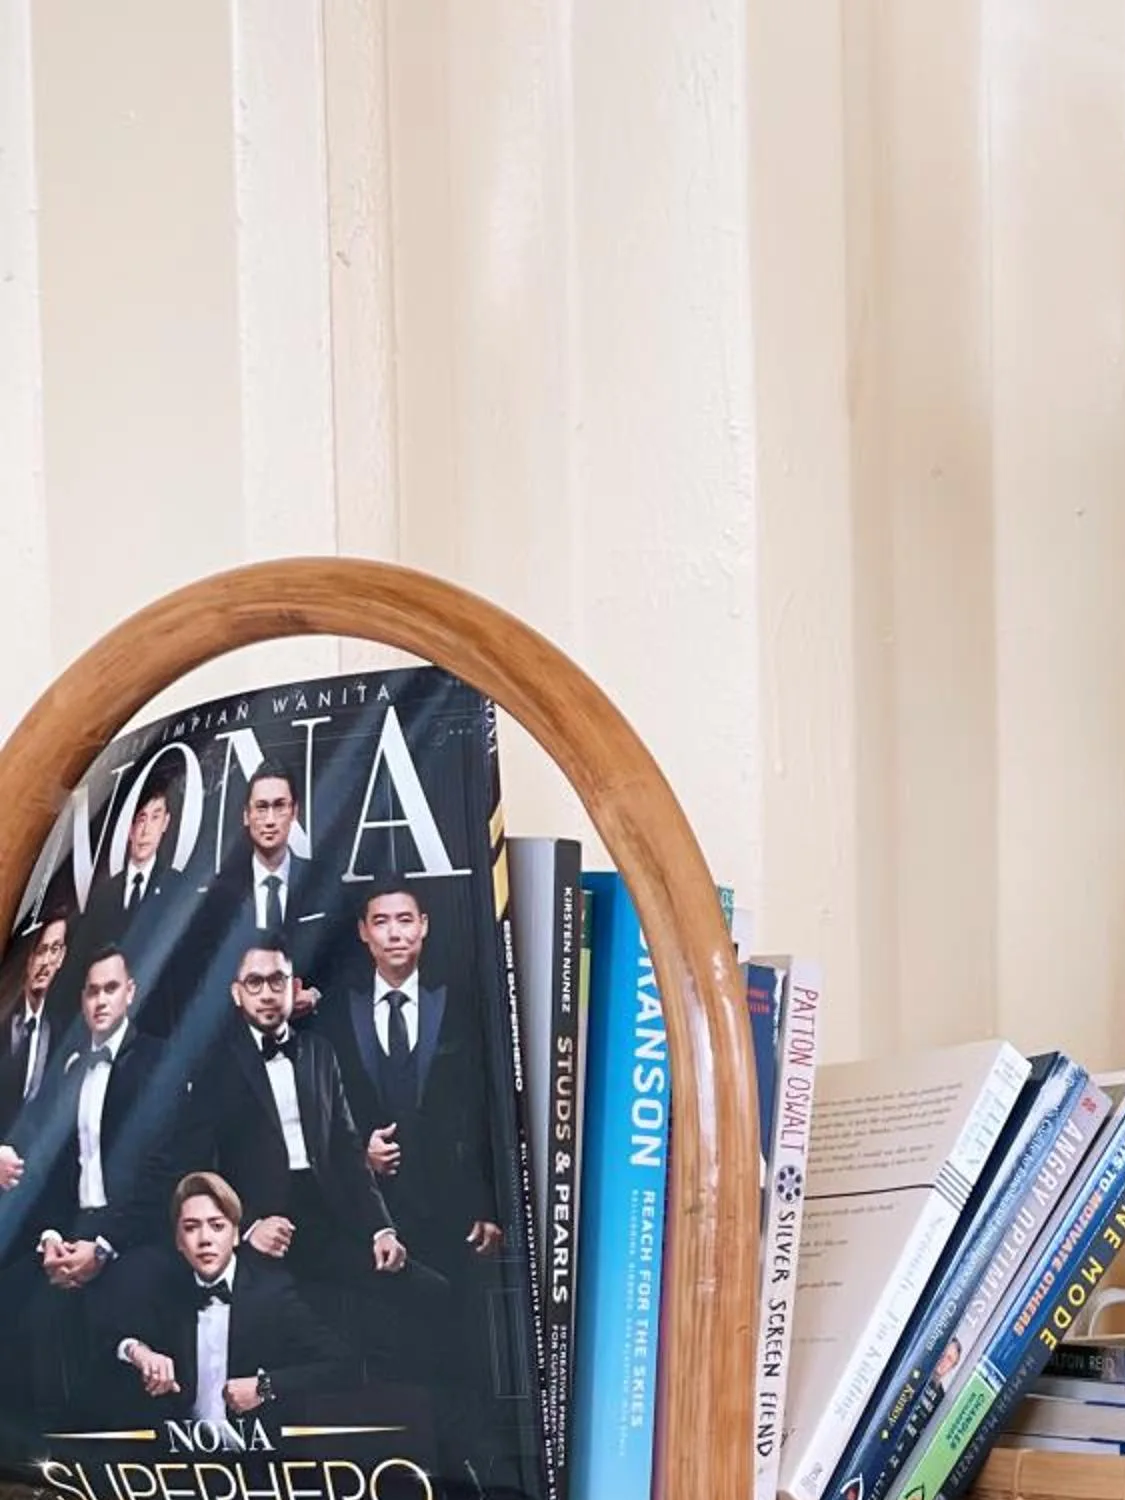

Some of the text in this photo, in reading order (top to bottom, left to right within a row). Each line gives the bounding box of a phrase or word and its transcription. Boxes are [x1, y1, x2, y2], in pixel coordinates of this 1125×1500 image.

[162, 683, 391, 742] IMPIAN WANITA
[561, 886, 573, 1013] KIRSTEN NUNEZ
[629, 928, 668, 1167] ANSON
[779, 986, 819, 1152] PATTON OSWALT
[552, 1037, 573, 1304] STUDS & PEARLS
[1098, 1168, 1117, 1191] TO
[967, 1120, 1085, 1331] ANGRY OPTIMIST
[1052, 1191, 1103, 1270] MOTIVATE
[631, 1191, 657, 1428] REACH FOR THE SKIES
[757, 1210, 796, 1458] SILVER SCREEN FIEND
[926, 1301, 957, 1351] Children
[1012, 1272, 1055, 1336] OTHERS
[1041, 1257, 1102, 1348] MODE
[168, 1418, 276, 1453] NONA
[949, 1393, 985, 1449] CHANDLER
